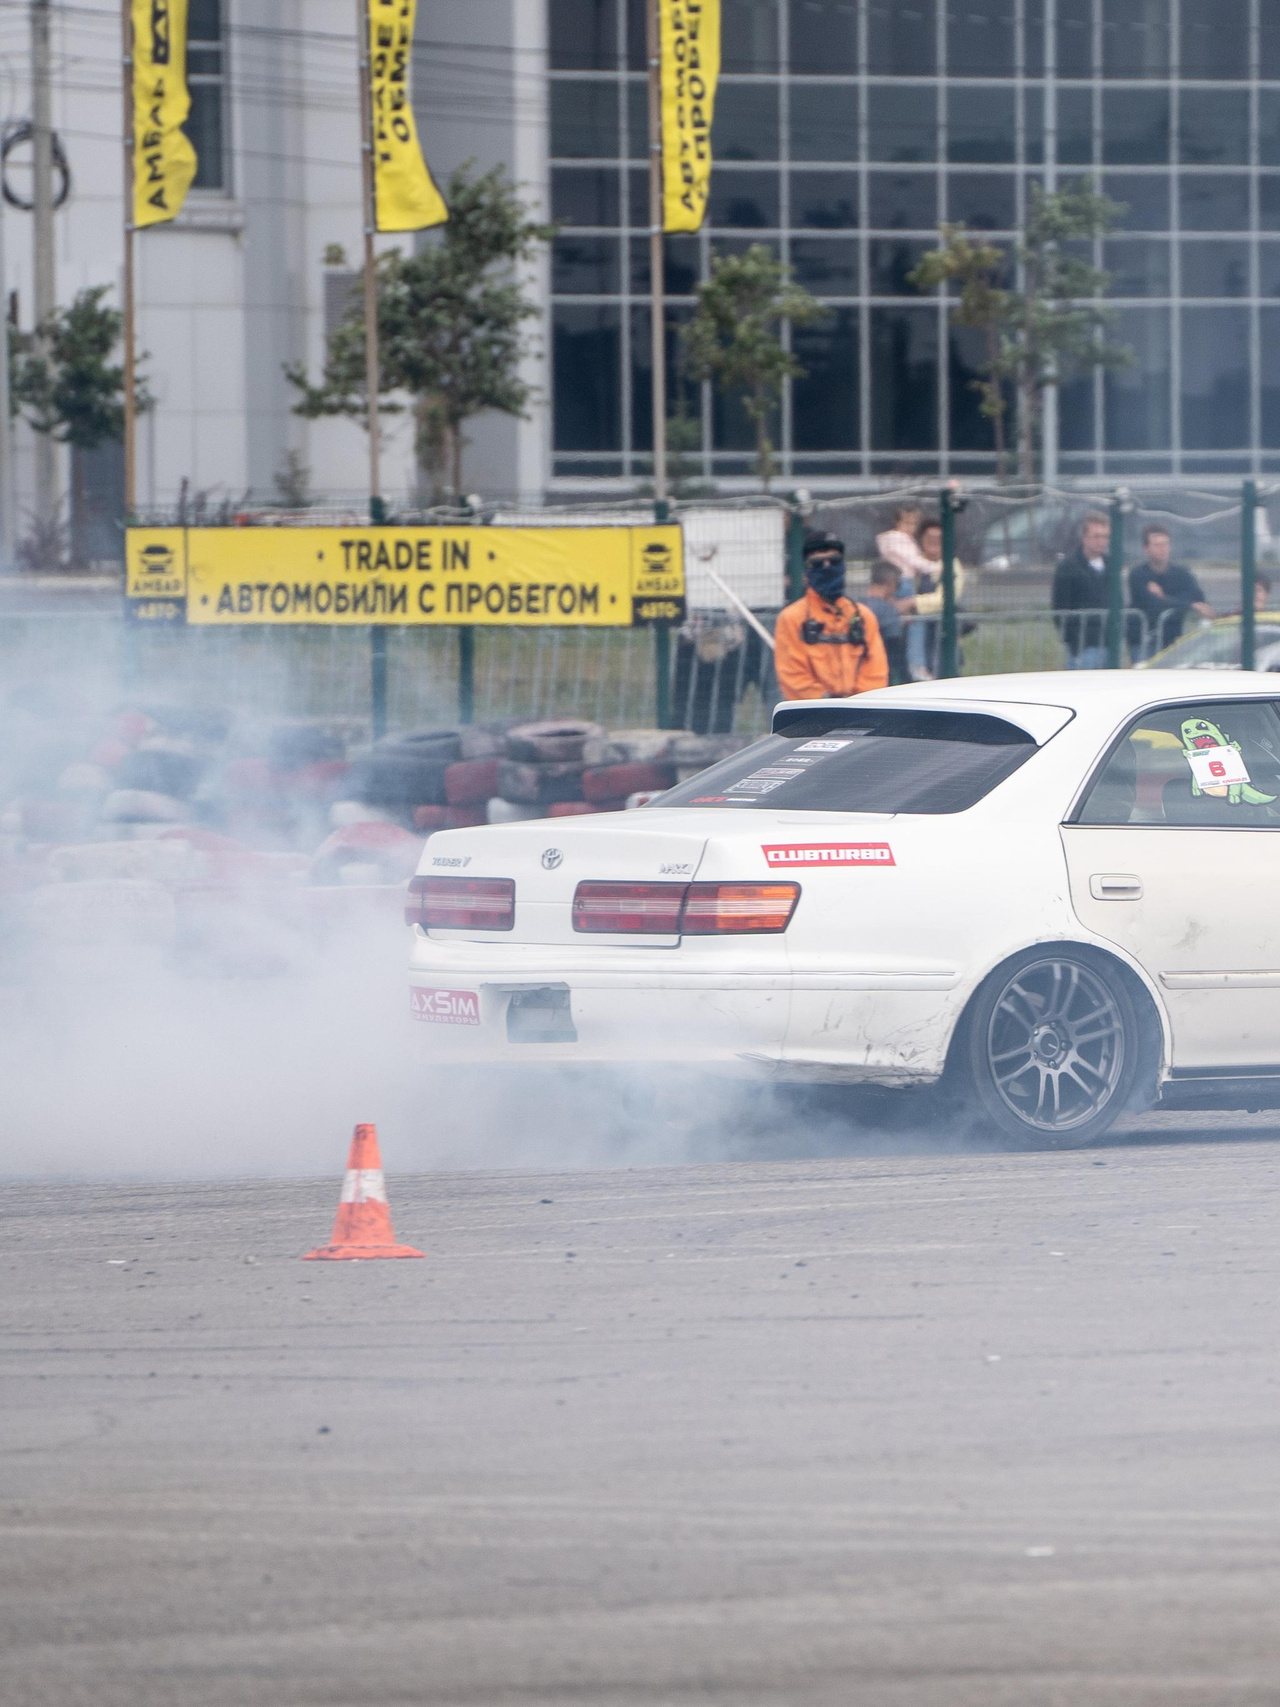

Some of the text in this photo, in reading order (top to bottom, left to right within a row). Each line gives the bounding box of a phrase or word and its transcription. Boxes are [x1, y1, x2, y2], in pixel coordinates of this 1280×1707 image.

[340, 540, 470, 571] TRADE IN
[216, 581, 600, 614] АВТОМОБИЛИ С ПРОБЕГОМ
[1208, 761, 1226, 777] 6
[767, 848, 890, 862] CLUBTURBO
